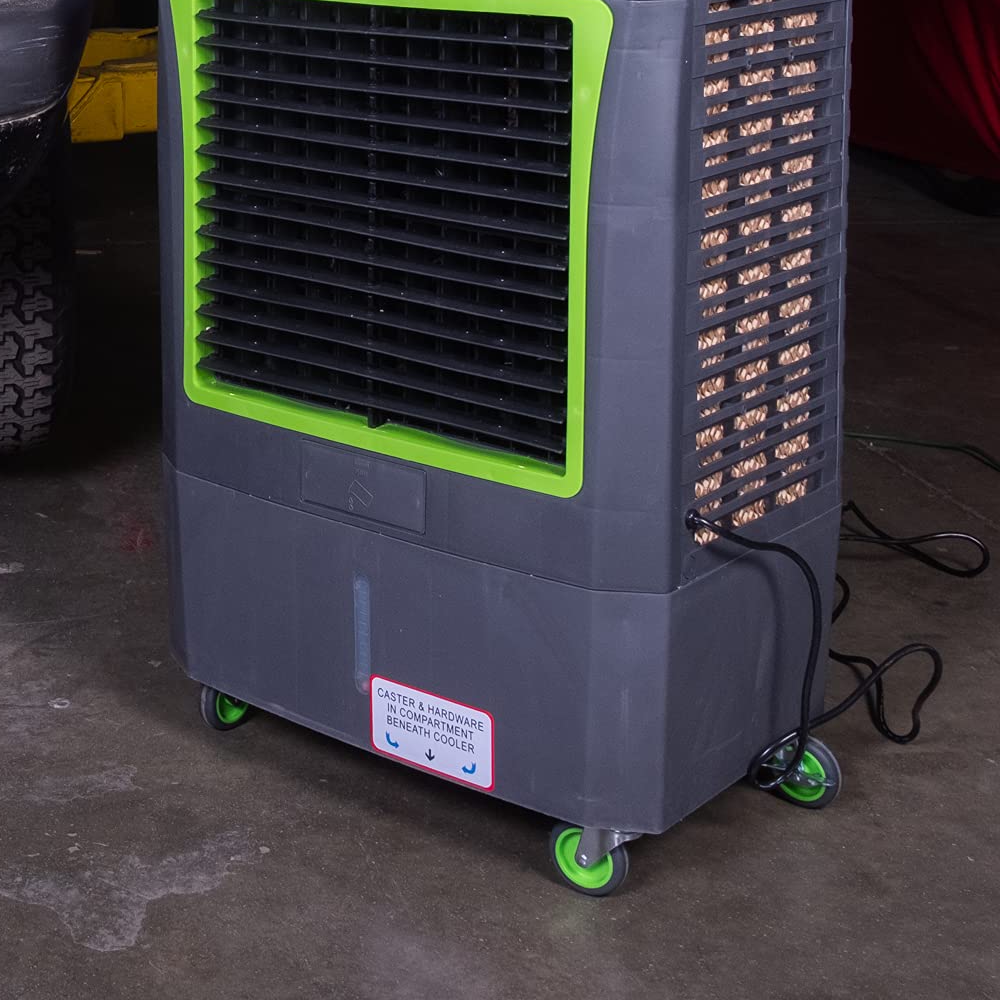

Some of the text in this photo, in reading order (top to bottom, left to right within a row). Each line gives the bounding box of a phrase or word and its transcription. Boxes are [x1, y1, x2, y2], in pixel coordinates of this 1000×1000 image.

[377, 687, 484, 732] CASTER & HARDWARE
[387, 702, 474, 741] IN COMPARTMENT
[386, 714, 475, 754] BENEATH COOLER
